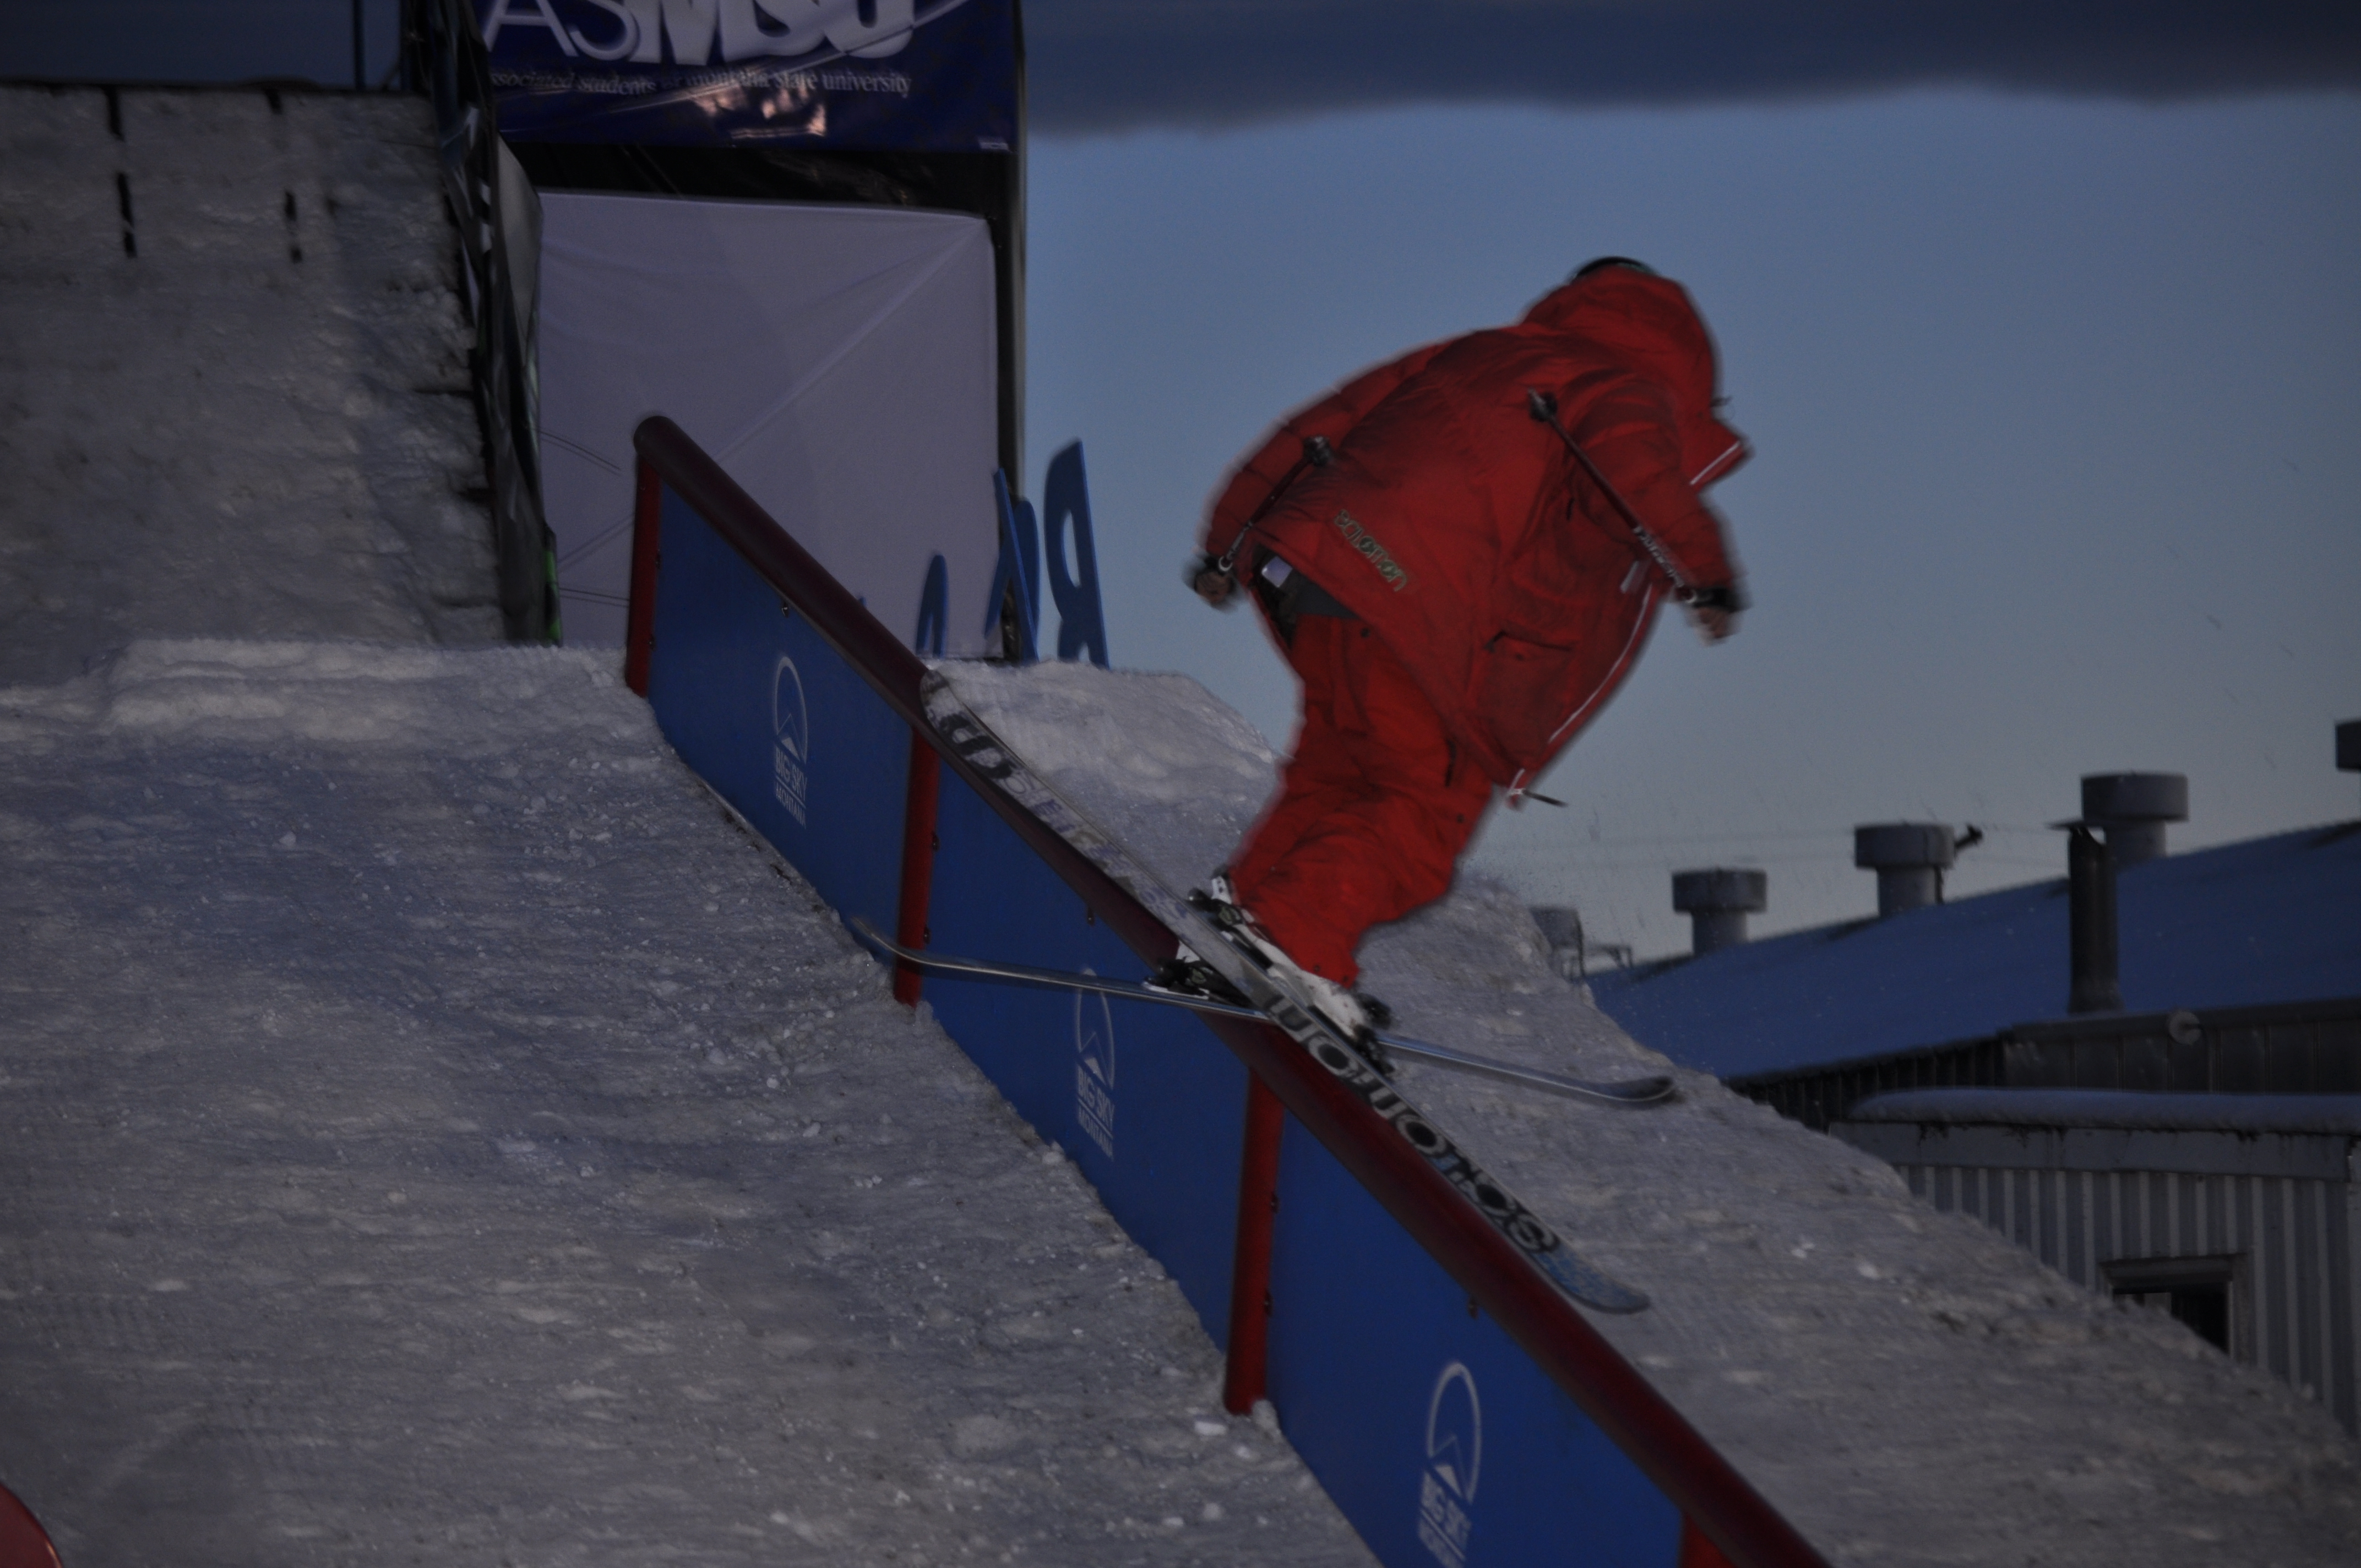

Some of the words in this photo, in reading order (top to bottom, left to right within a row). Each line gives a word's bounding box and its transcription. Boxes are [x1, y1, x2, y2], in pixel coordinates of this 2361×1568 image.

[578, 72, 657, 95] students
[773, 67, 818, 90] state
[822, 68, 911, 98] university
